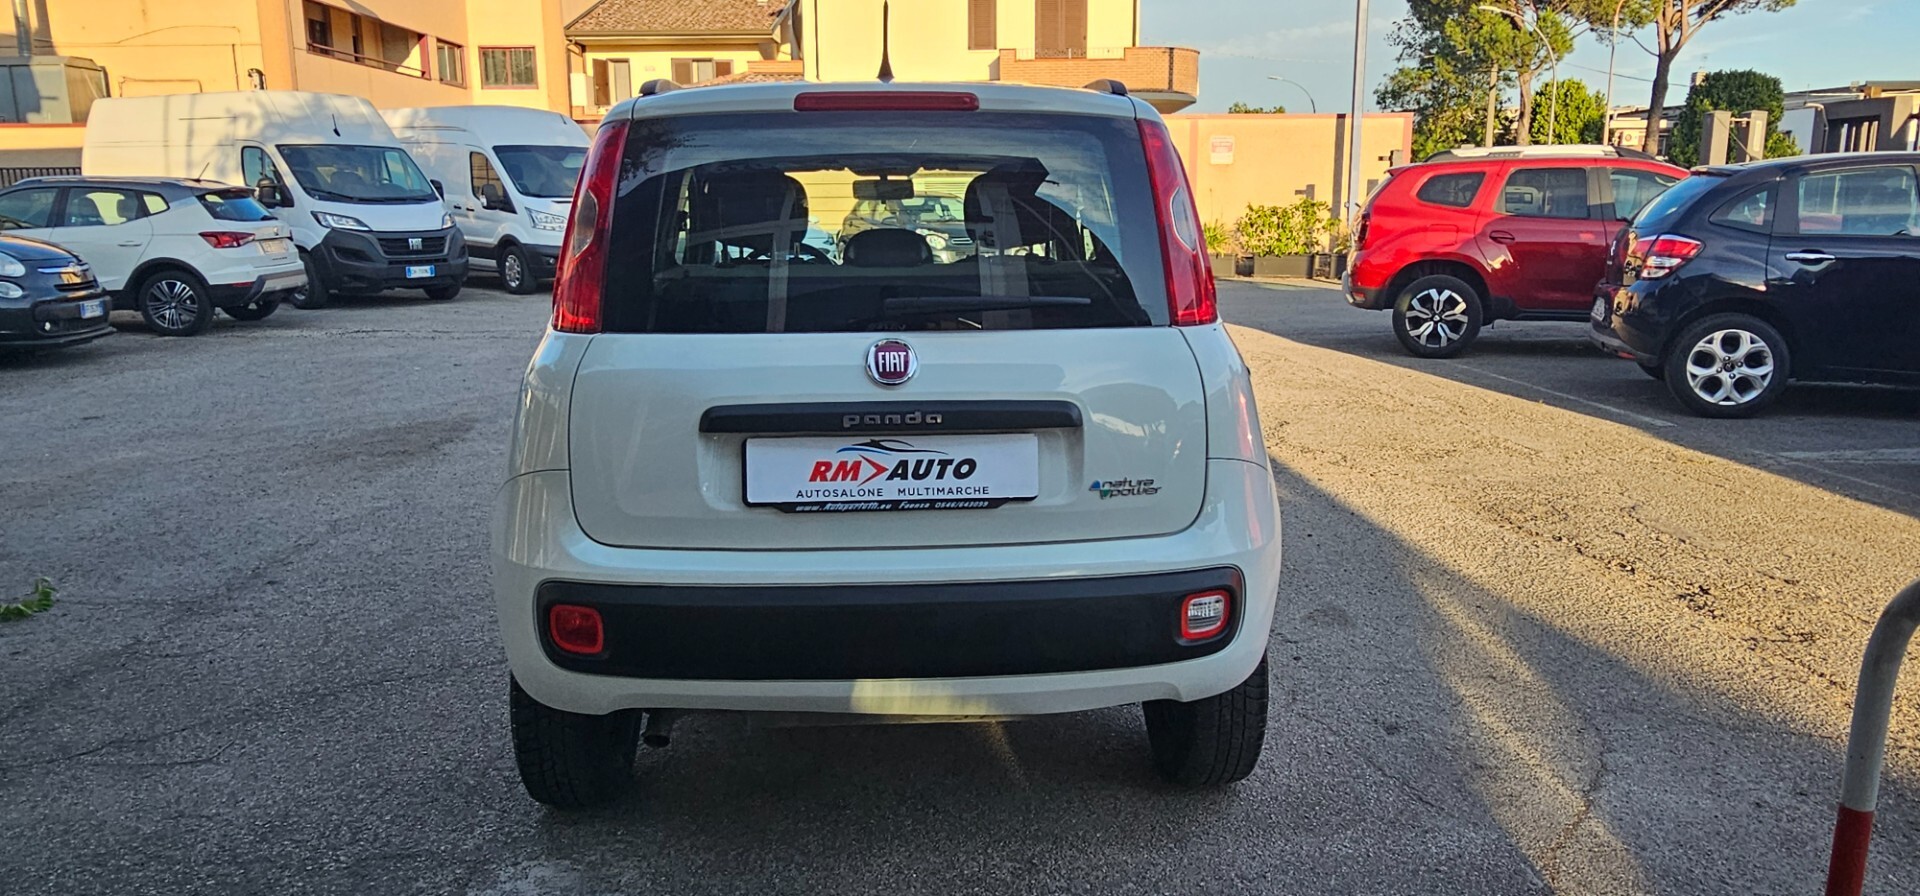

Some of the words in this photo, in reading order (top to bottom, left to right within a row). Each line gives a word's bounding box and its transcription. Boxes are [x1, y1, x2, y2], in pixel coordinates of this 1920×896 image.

[877, 351, 907, 373] FIAT
[842, 411, 943, 428] panda
[808, 460, 863, 482] RM
[885, 457, 978, 481] AUTO
[795, 487, 884, 499] AUTOSALONE
[897, 486, 990, 496] MULTIMARCHE
[898, 501, 932, 509] Faenza
